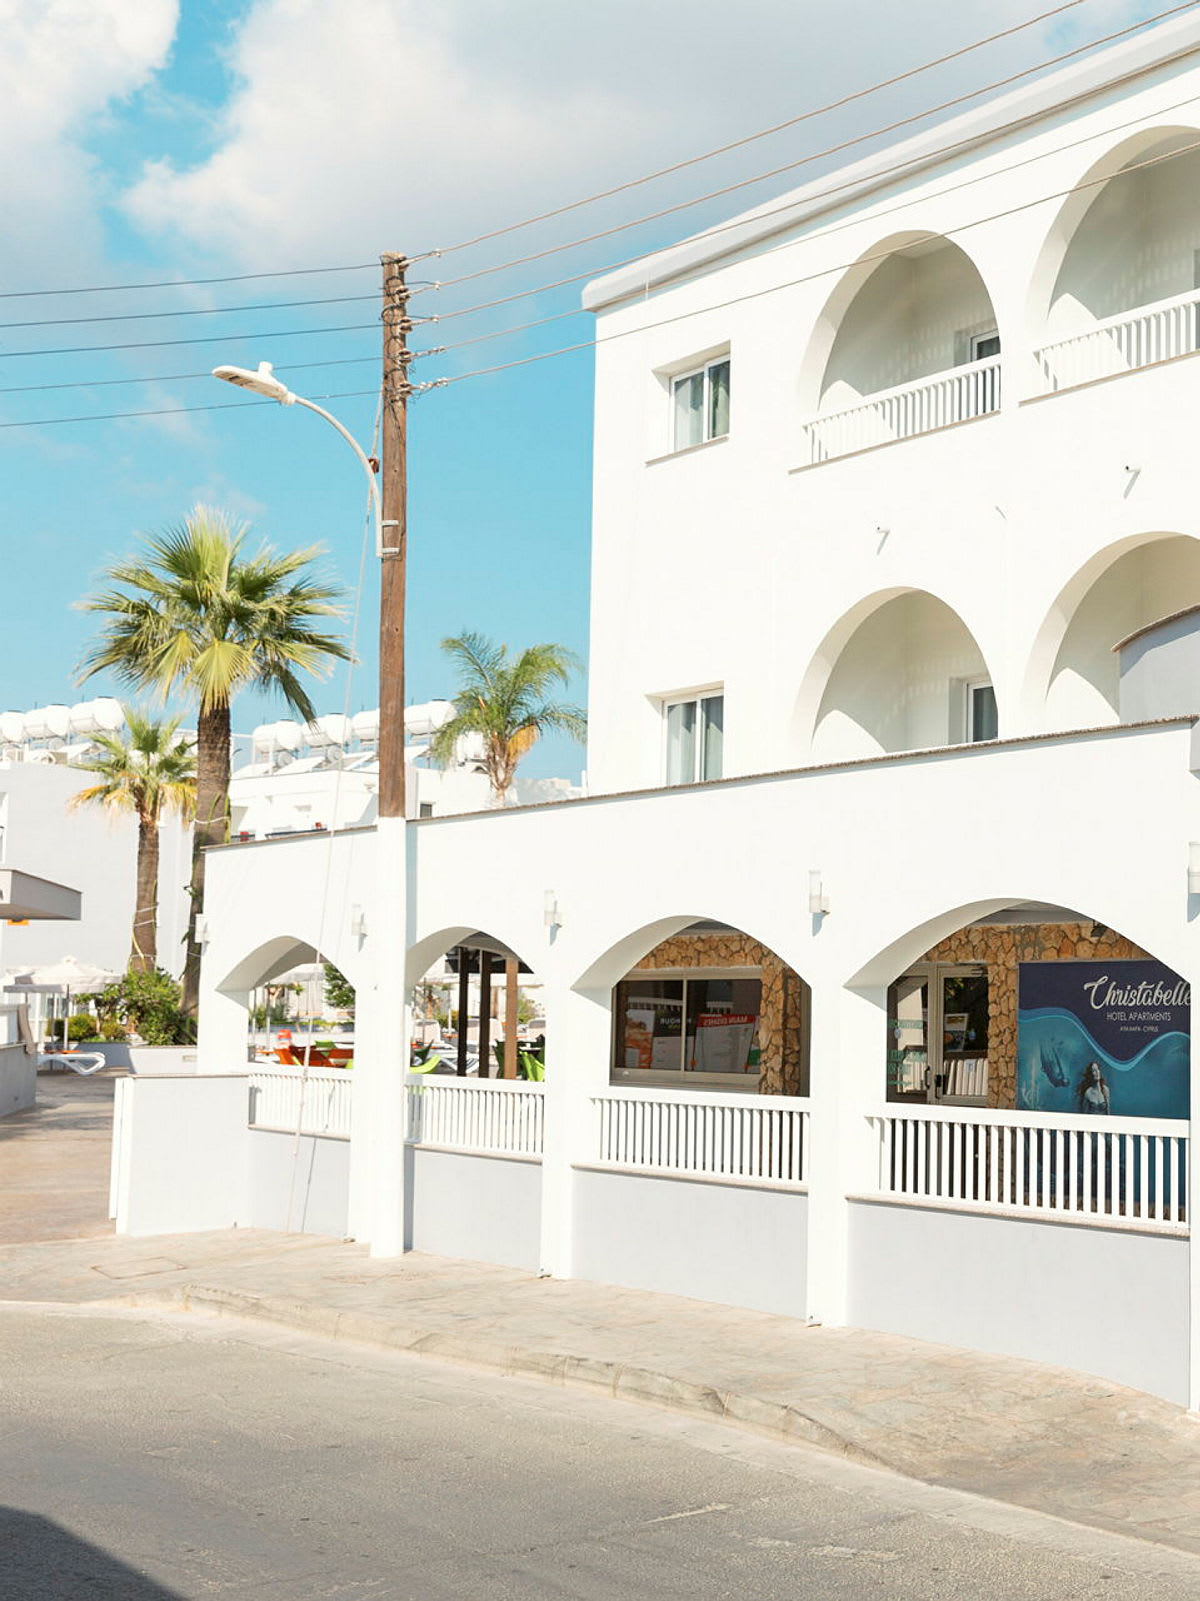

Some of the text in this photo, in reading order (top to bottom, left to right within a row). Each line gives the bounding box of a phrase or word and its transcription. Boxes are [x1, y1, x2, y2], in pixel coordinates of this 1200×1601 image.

[1083, 975, 1191, 1010] Christabelle
[1106, 1011, 1172, 1021] HOTEL APARTMENTS
